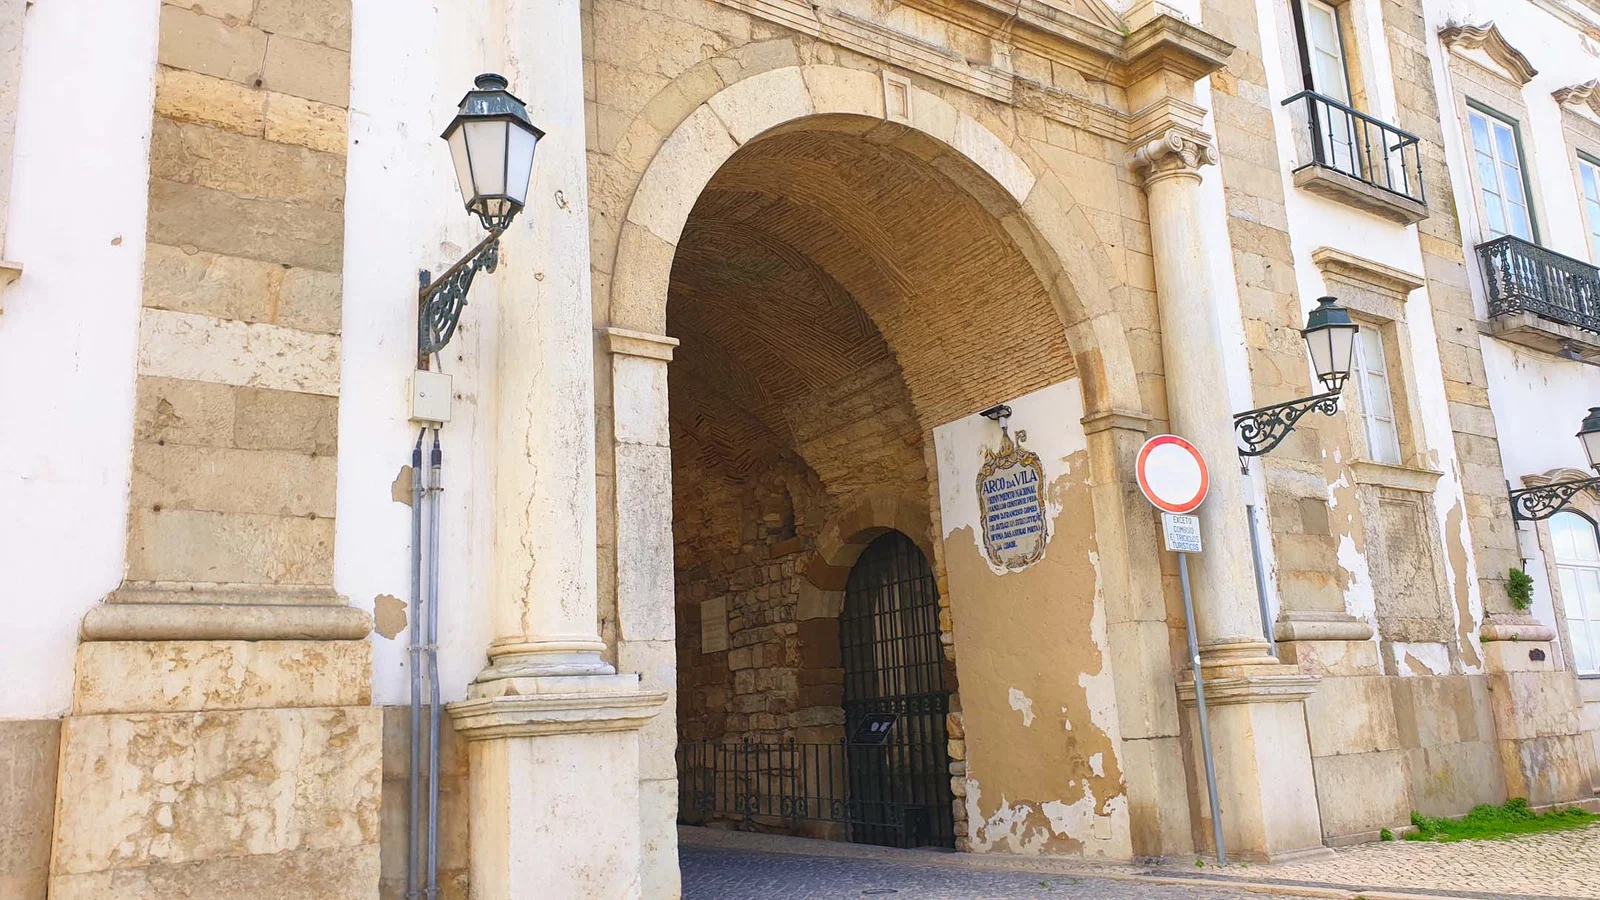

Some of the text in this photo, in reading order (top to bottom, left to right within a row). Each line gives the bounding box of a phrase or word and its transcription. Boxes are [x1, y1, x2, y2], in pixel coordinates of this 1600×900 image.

[983, 469, 1038, 495] ARCO DA VILA
[1173, 516, 1192, 524] EXCETO
